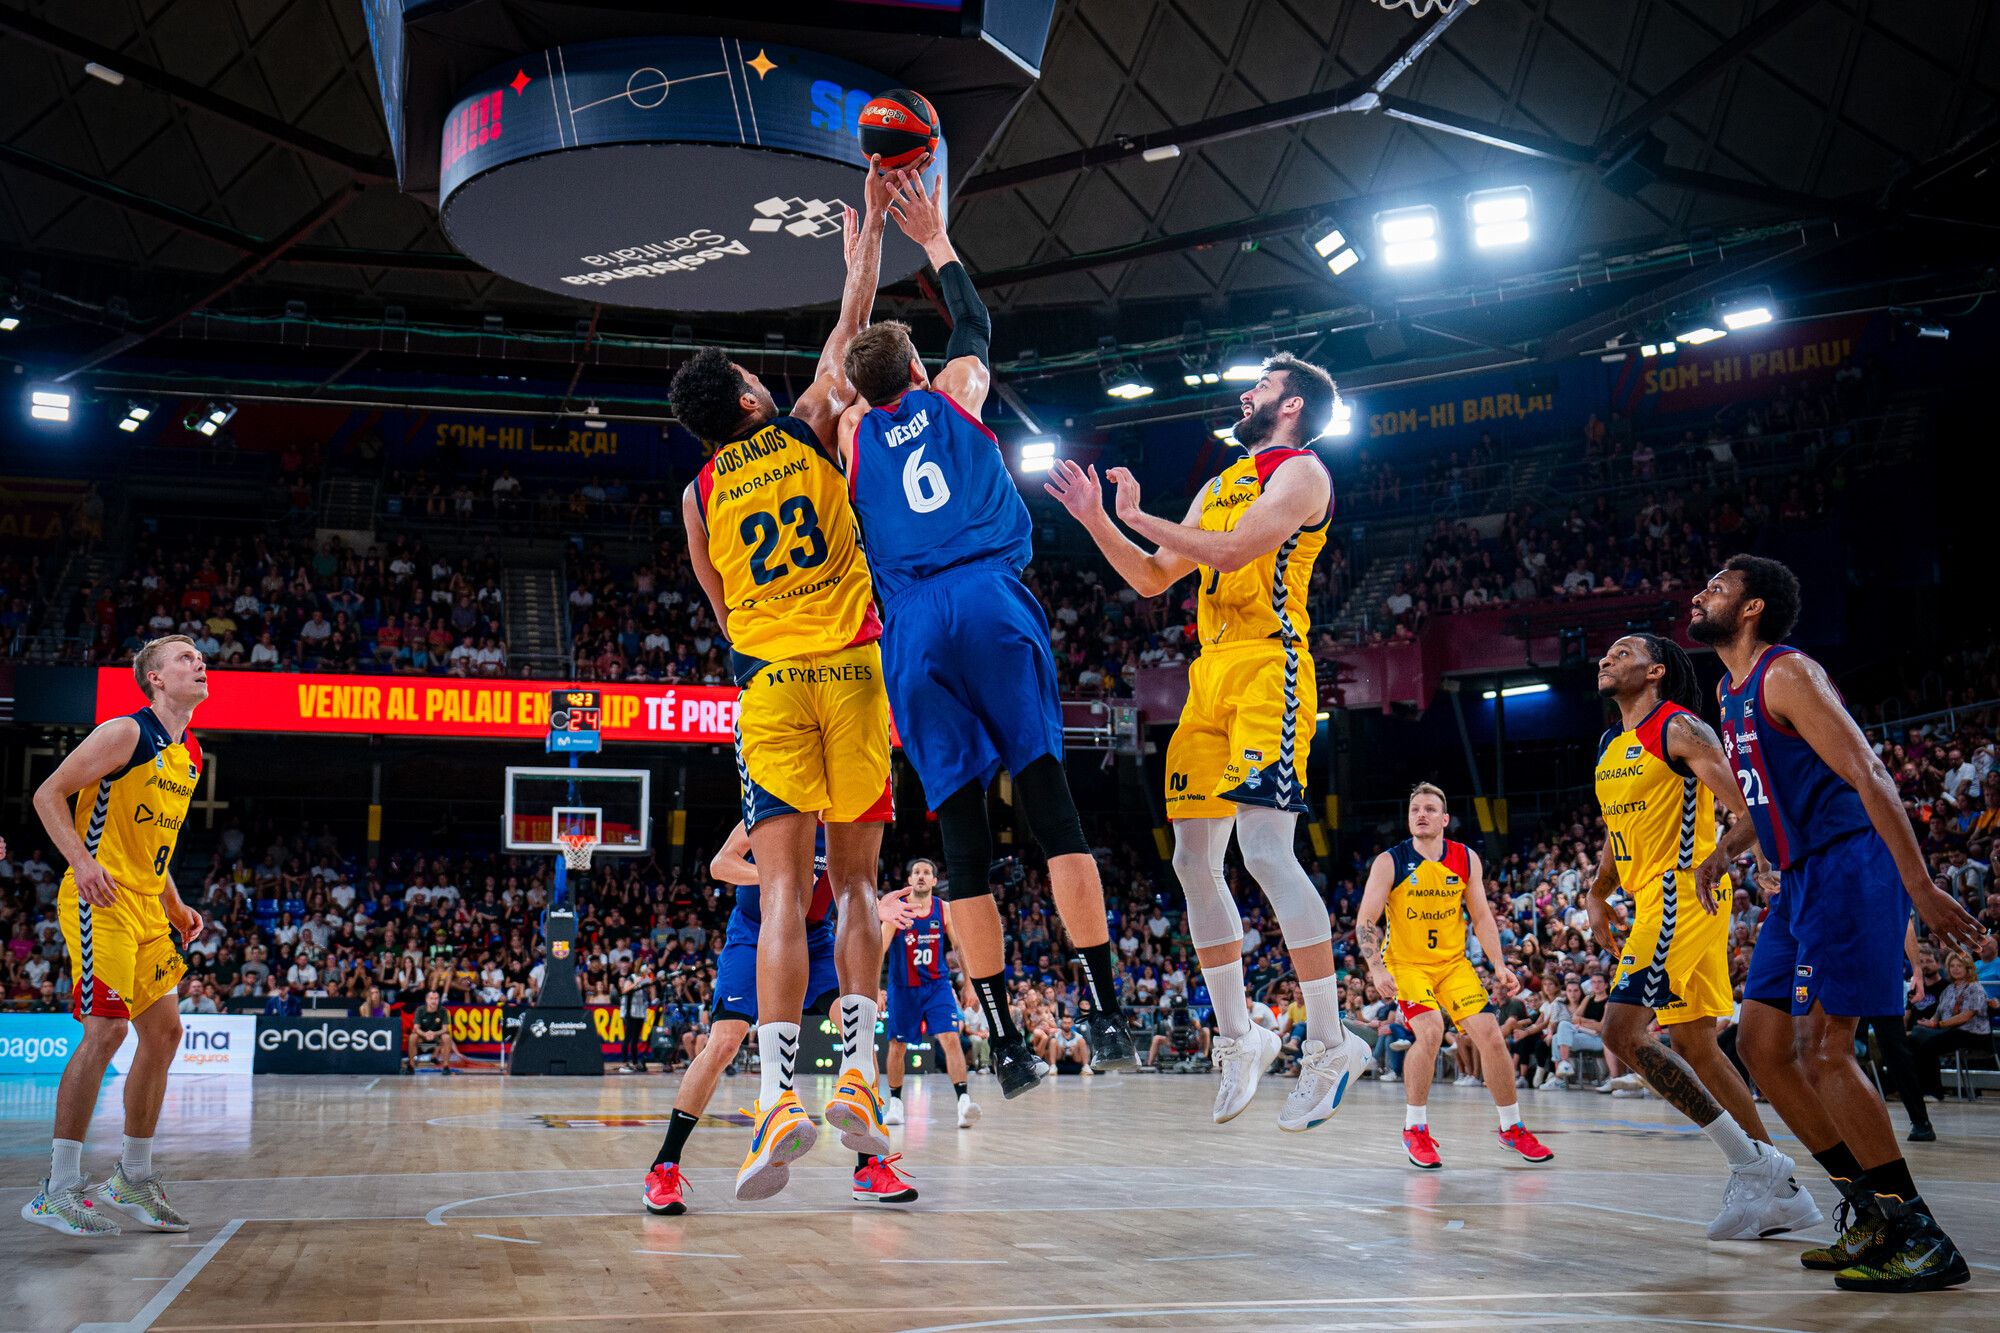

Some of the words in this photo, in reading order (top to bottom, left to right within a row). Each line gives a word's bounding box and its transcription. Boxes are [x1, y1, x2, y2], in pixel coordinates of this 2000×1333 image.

[560, 240, 750, 286] Assistència
[1645, 356, 1742, 394] SOM-HI
[885, 409, 929, 448] VESELY
[1370, 402, 1455, 438] SOM-HI
[436, 424, 523, 449] SOM-HI
[531, 428, 617, 458] RÇA!
[741, 427, 787, 465] ANJOS
[730, 458, 810, 501] MORABANC
[903, 443, 951, 513] 6
[740, 495, 828, 586] 23
[298, 684, 381, 720] VENIR
[386, 687, 419, 721] AL
[426, 688, 511, 724] PALAU
[645, 690, 675, 730] TÉ
[682, 700, 741, 733] PRE
[569, 710, 598, 731] 24
[157, 779, 193, 797] MORABA
[153, 812, 182, 830] Ando
[154, 846, 170, 876] 8
[1610, 831, 1631, 861] 11
[1428, 930, 1438, 949] 5
[913, 949, 932, 966] 20
[259, 1023, 392, 1050] endesa
[184, 1053, 229, 1064] seguros
